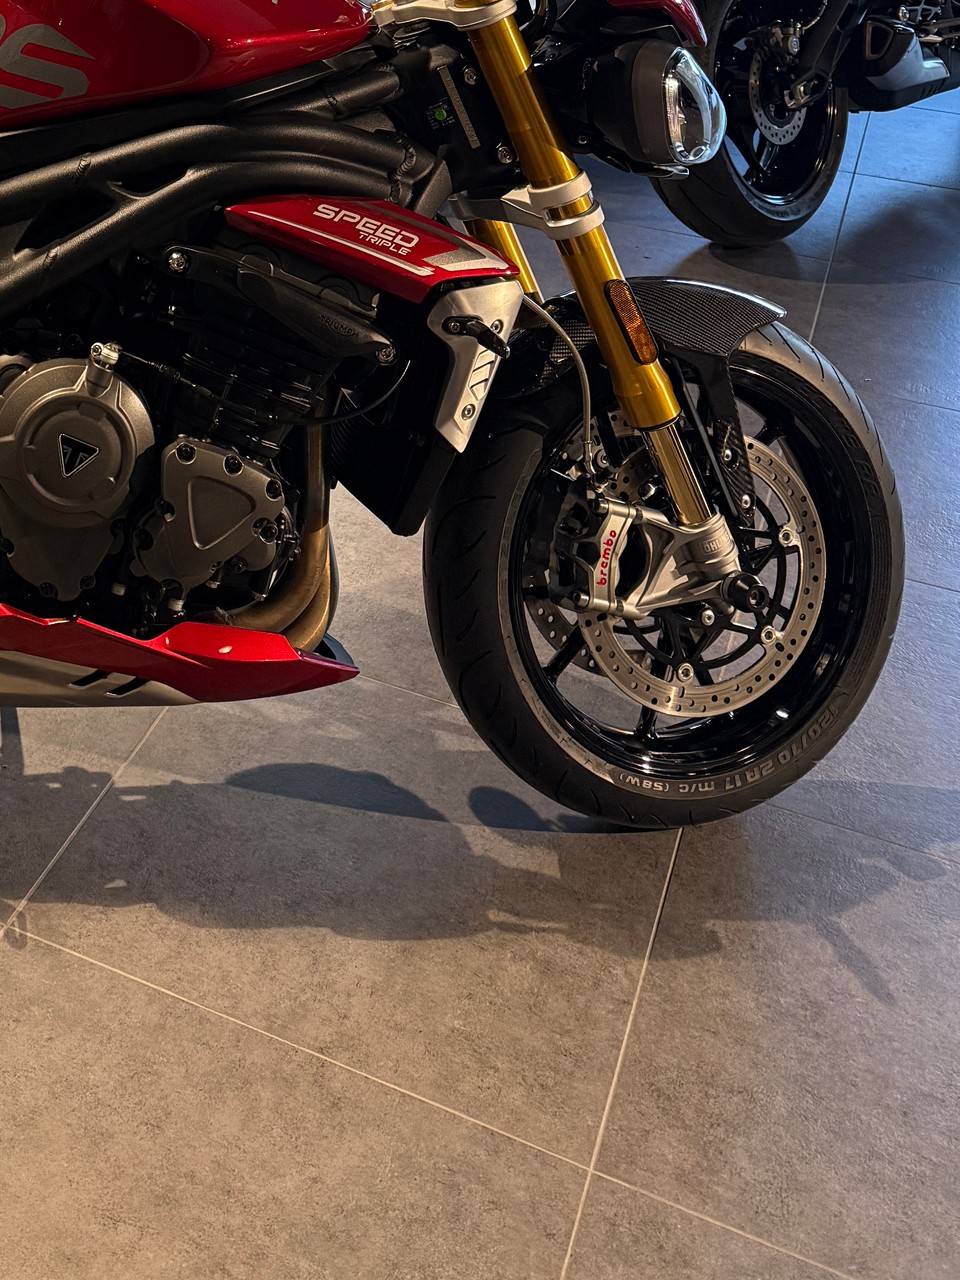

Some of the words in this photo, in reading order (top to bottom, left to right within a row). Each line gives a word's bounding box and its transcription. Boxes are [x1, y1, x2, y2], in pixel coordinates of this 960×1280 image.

[313, 203, 420, 249] SPEED
[358, 231, 412, 256] TRIPLE
[596, 529, 617, 587] brembo
